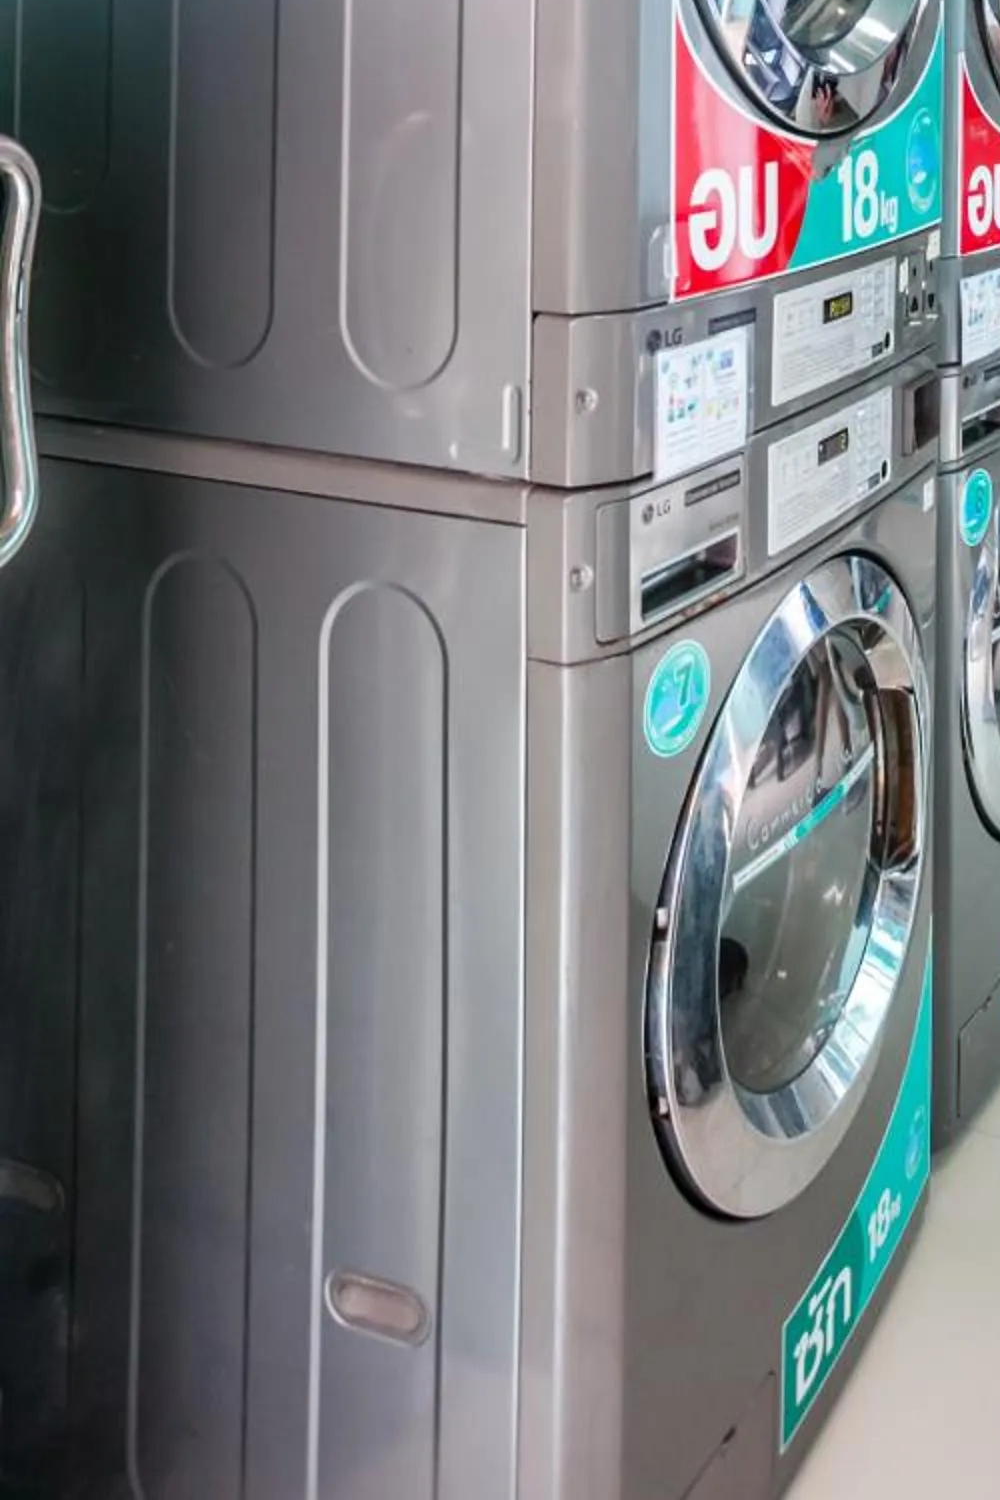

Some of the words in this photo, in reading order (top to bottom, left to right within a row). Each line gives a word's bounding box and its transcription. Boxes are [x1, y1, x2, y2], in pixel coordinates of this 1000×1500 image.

[689, 162, 779, 271] อบ
[664, 326, 683, 348] LG
[656, 498, 671, 517] LG
[673, 661, 694, 707] 7
